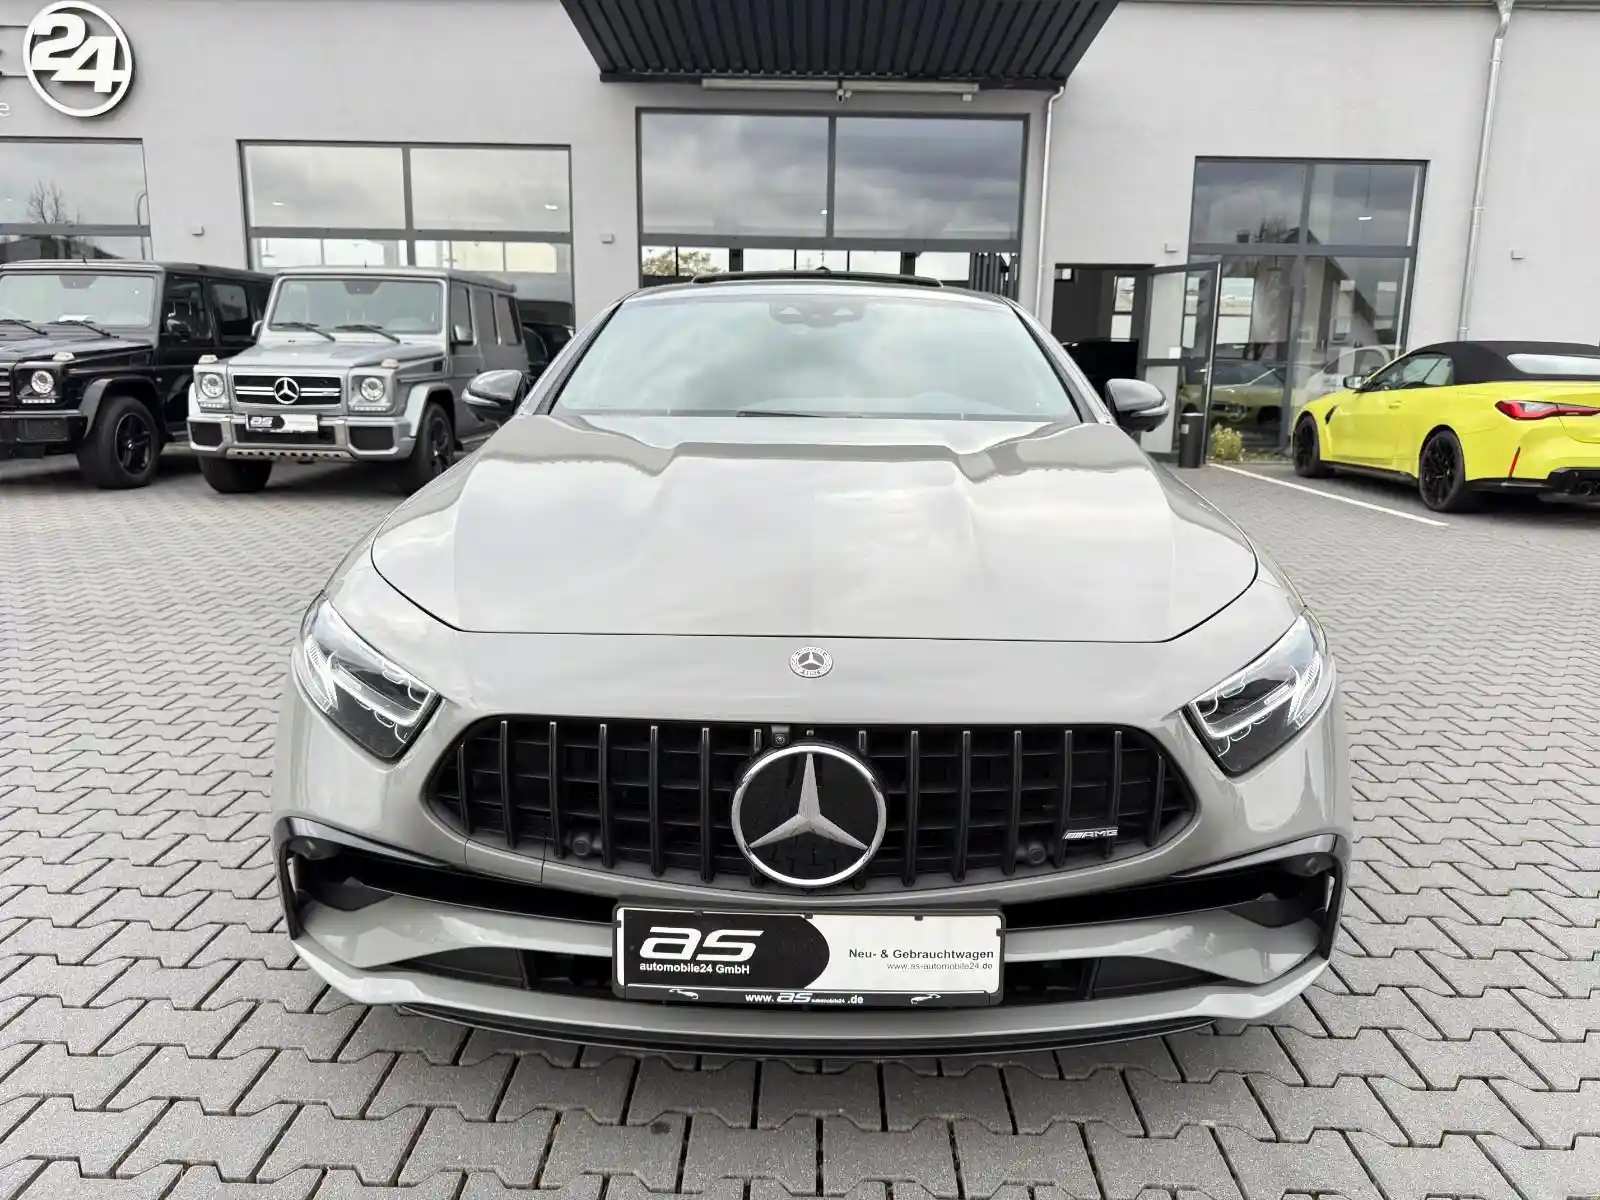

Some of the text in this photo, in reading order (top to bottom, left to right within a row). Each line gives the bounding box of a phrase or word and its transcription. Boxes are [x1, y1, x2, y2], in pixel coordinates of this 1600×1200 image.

[31, 13, 125, 92] 24
[1081, 829, 1118, 838] AMG
[639, 926, 764, 962] as
[849, 949, 994, 961] Neu- & Gebrauchtwagen
[639, 962, 750, 974] automobile24 GmbH
